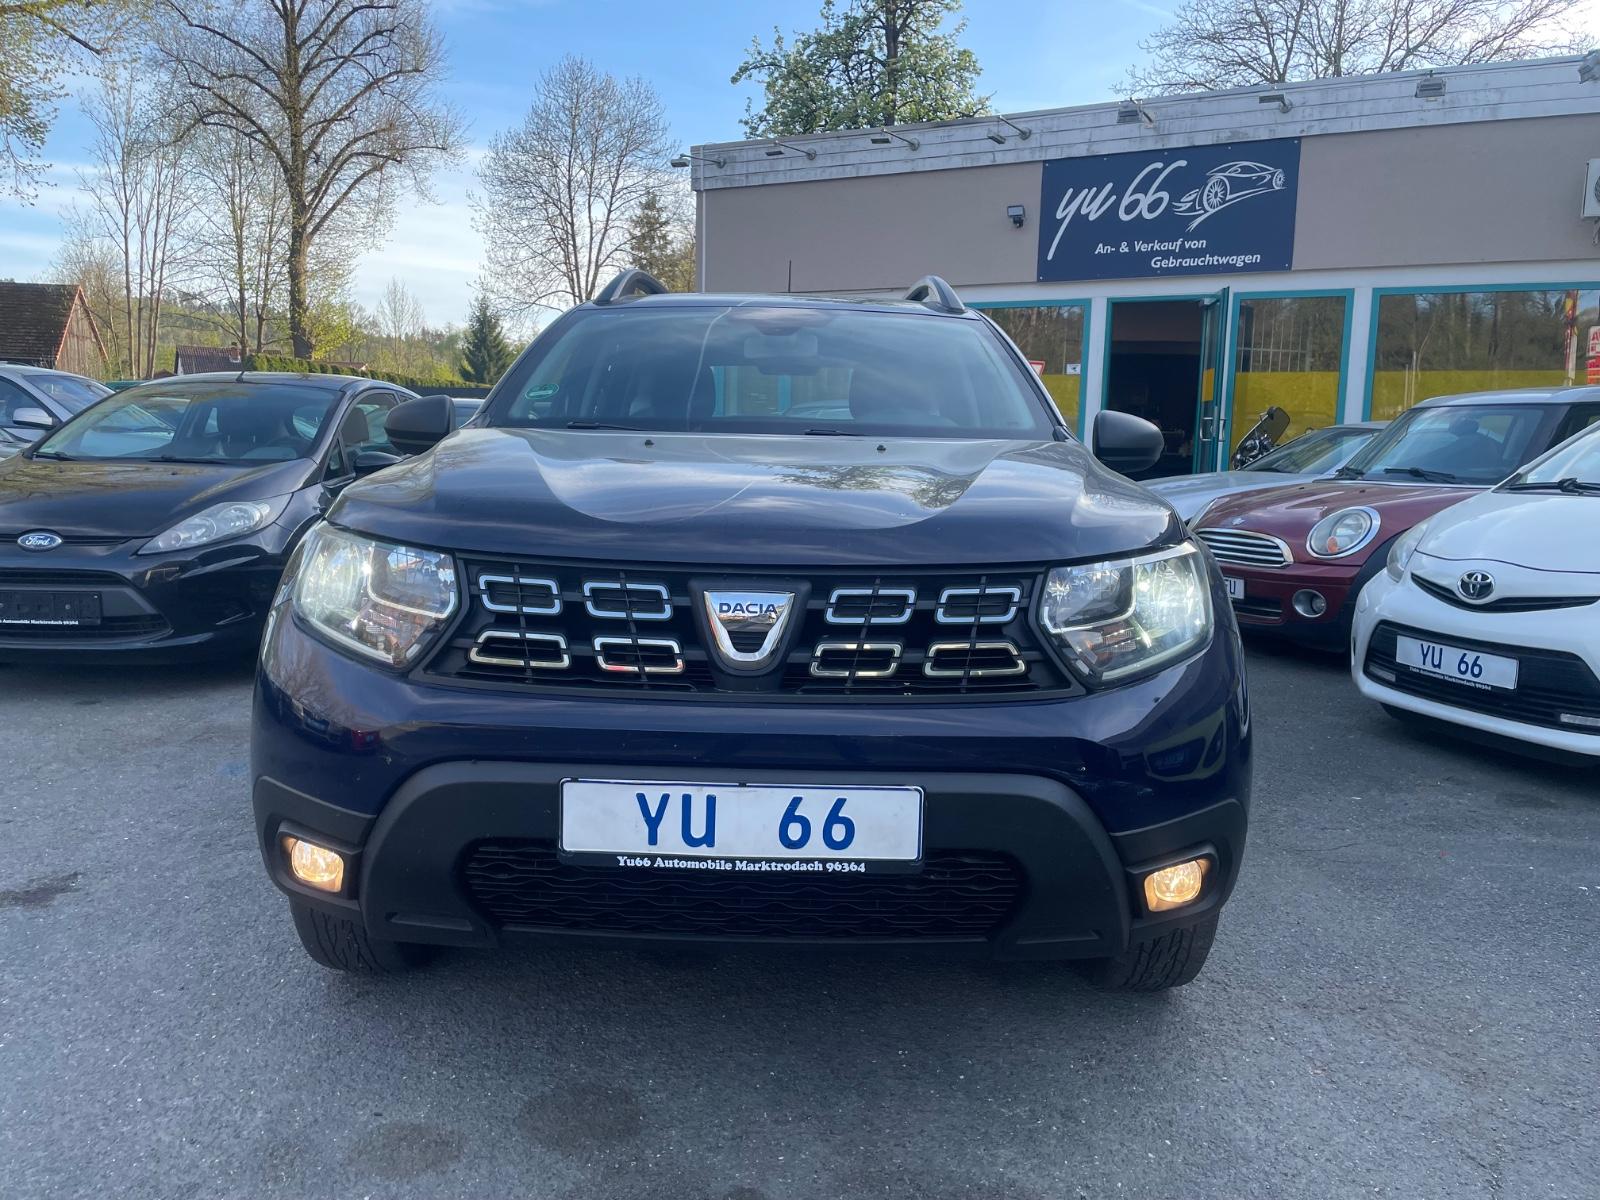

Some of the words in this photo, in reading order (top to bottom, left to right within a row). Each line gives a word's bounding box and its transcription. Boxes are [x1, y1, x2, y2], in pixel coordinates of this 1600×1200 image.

[1119, 160, 1187, 221] 66
[1095, 242, 1116, 254] An-
[1119, 241, 1129, 253] &
[1134, 238, 1183, 253] Verkauf
[1184, 239, 1207, 249] von
[1151, 254, 1261, 268] Gebrauchtwagen
[25, 535, 51, 546] Ford
[718, 602, 778, 614] DACIA
[1420, 643, 1443, 669] YU
[1457, 652, 1483, 678] 66
[635, 792, 717, 848] YU
[778, 796, 856, 850] 66
[616, 855, 652, 868] Yu66
[653, 857, 733, 871] Automobile
[735, 859, 824, 872] Marktrodach
[825, 861, 867, 873] 96364
